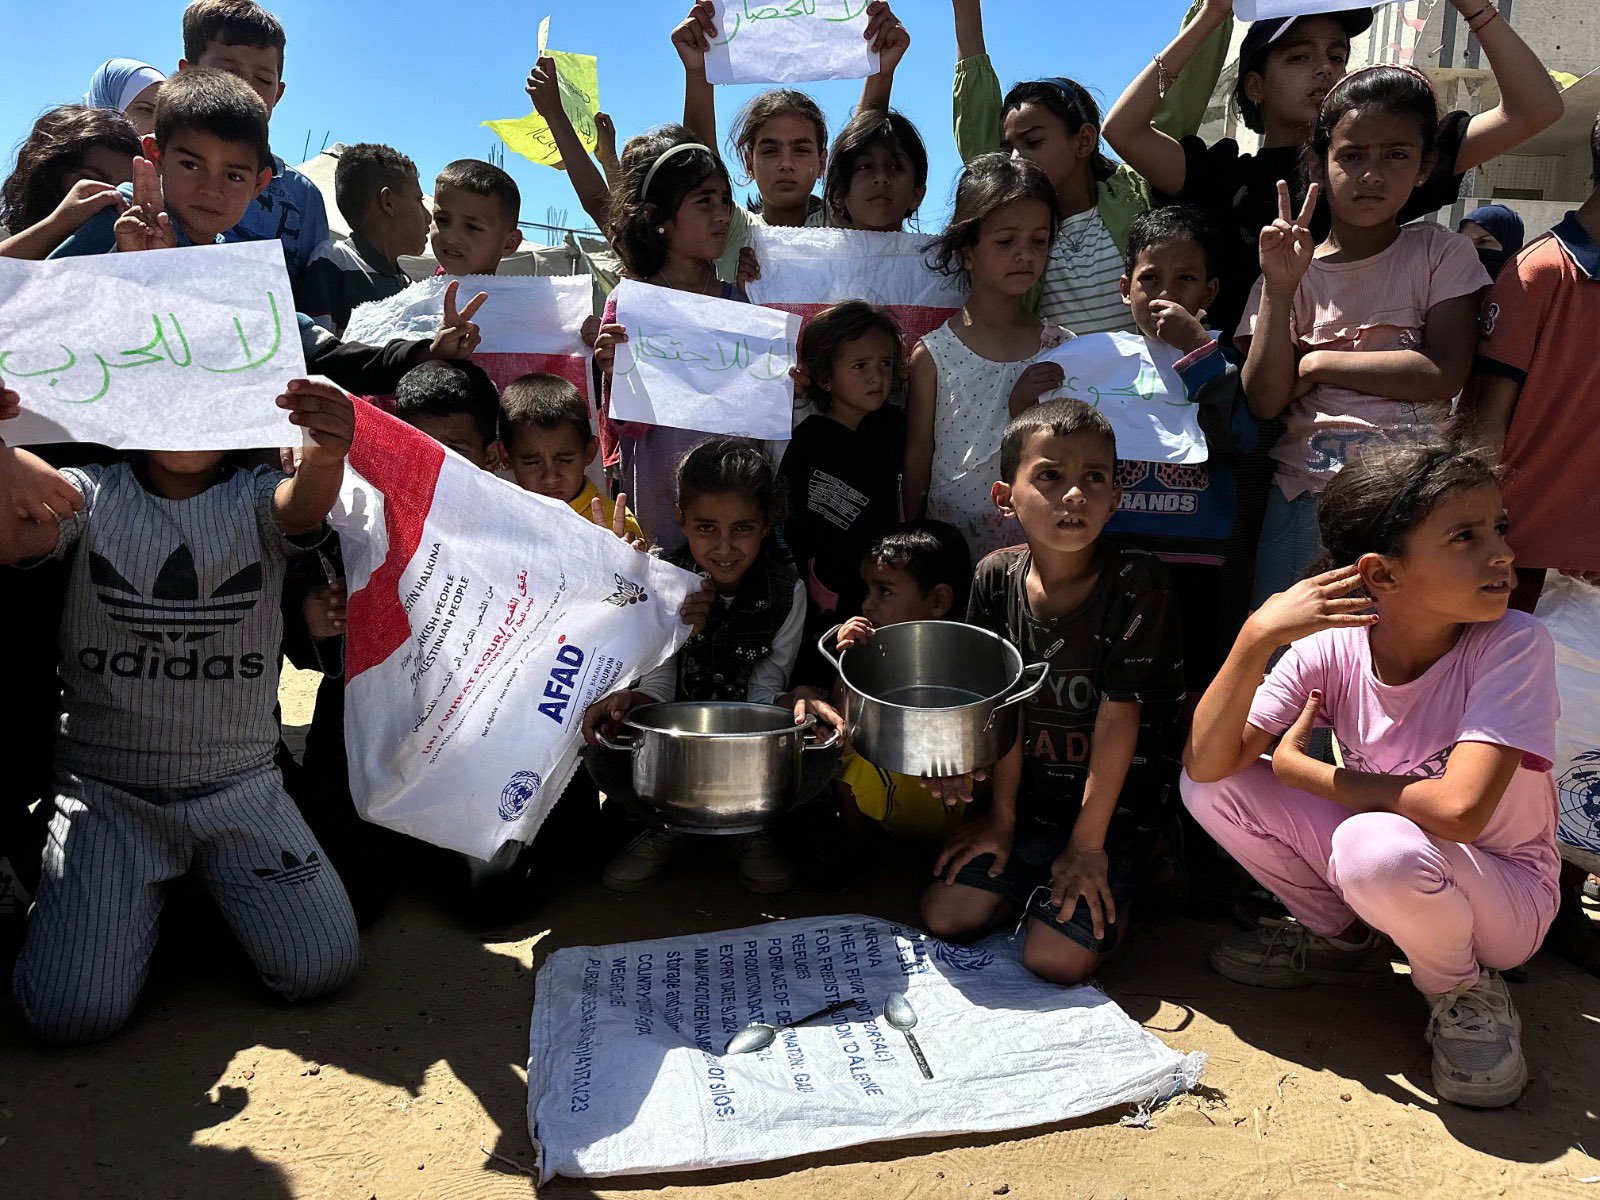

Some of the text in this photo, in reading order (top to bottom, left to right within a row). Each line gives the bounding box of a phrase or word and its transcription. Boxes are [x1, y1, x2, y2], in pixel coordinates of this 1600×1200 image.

[0, 291, 281, 404] لا للحرب
[615, 326, 792, 380] لا للاحتكار
[415, 542, 441, 591] HALKINA
[433, 572, 454, 615] PEOPLE
[447, 575, 470, 617] PEOPLE
[78, 645, 265, 680] adidas
[440, 676, 476, 722] WHEAT
[536, 644, 585, 724] AFAD
[718, 943, 733, 979] EXPIRY
[813, 927, 830, 955] FOR
[838, 924, 858, 965] WHEAT
[662, 949, 683, 989] storage
[665, 990, 683, 1007] and
[773, 991, 789, 1006] OF
